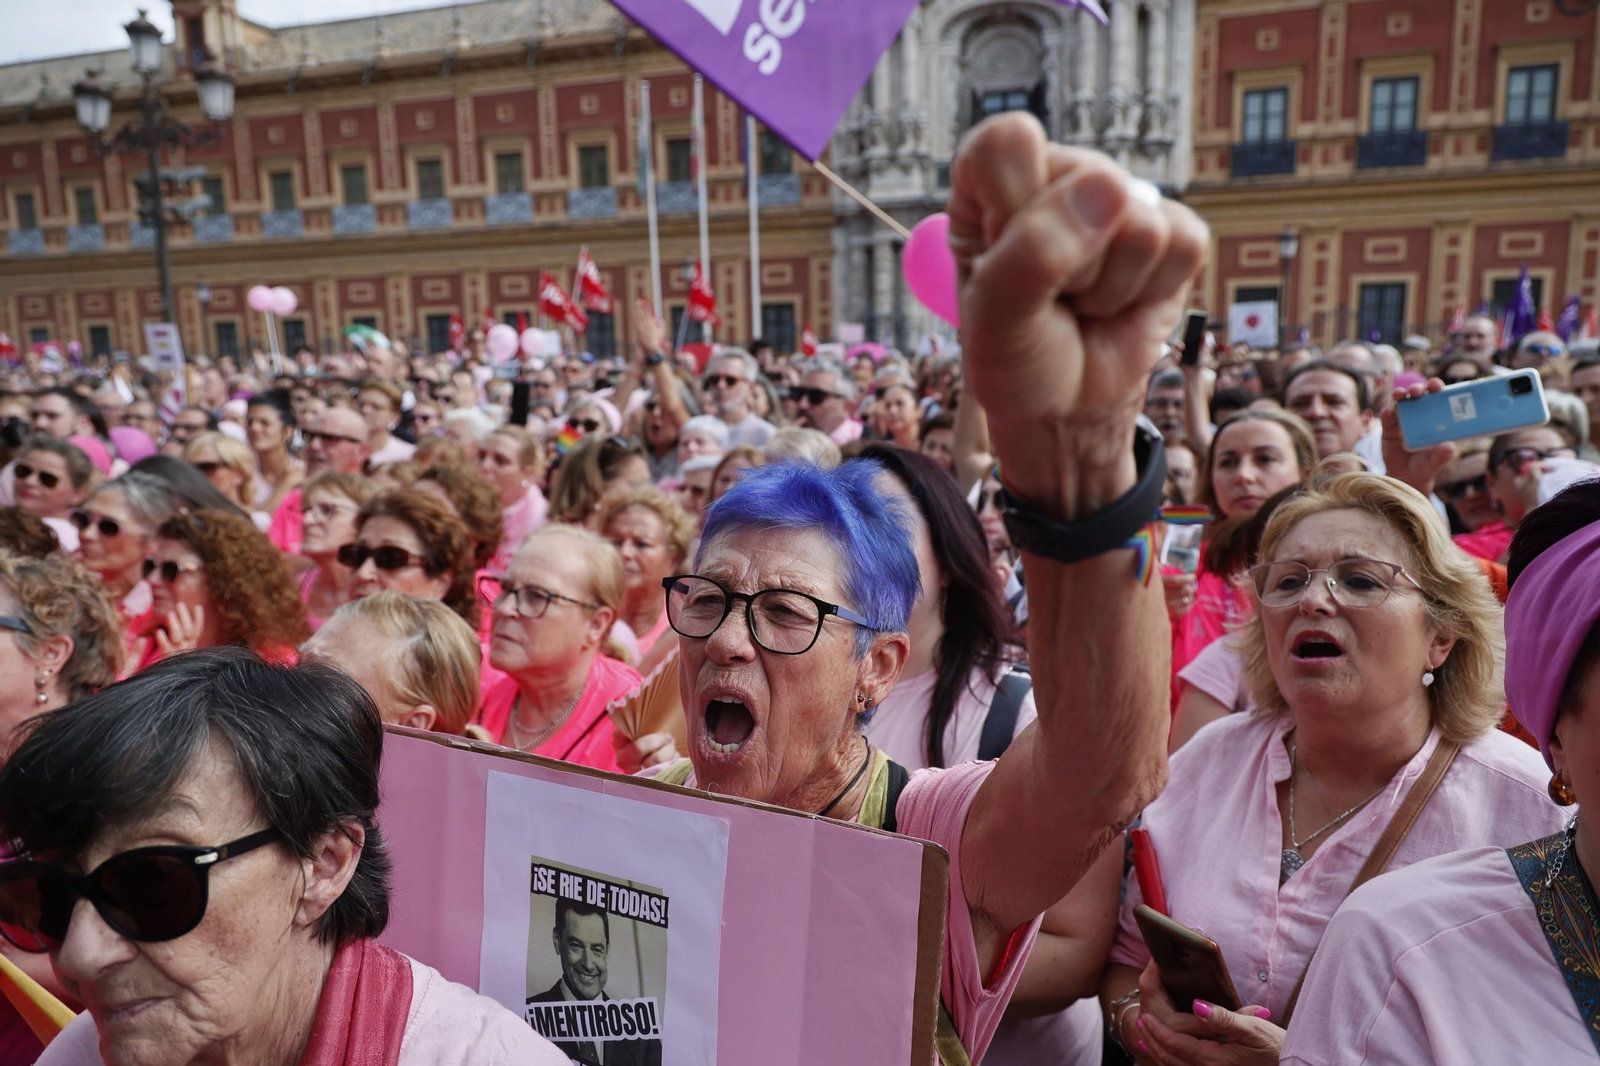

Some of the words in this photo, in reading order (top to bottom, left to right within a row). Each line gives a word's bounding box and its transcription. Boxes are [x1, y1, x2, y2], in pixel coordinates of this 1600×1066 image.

[743, 0, 815, 75] se
[533, 867, 555, 894] ¡SE
[560, 872, 582, 901] RIE
[587, 879, 605, 908] DE
[610, 885, 665, 925] TODAS!
[528, 1002, 659, 1037] ¡MENTIROSO!
